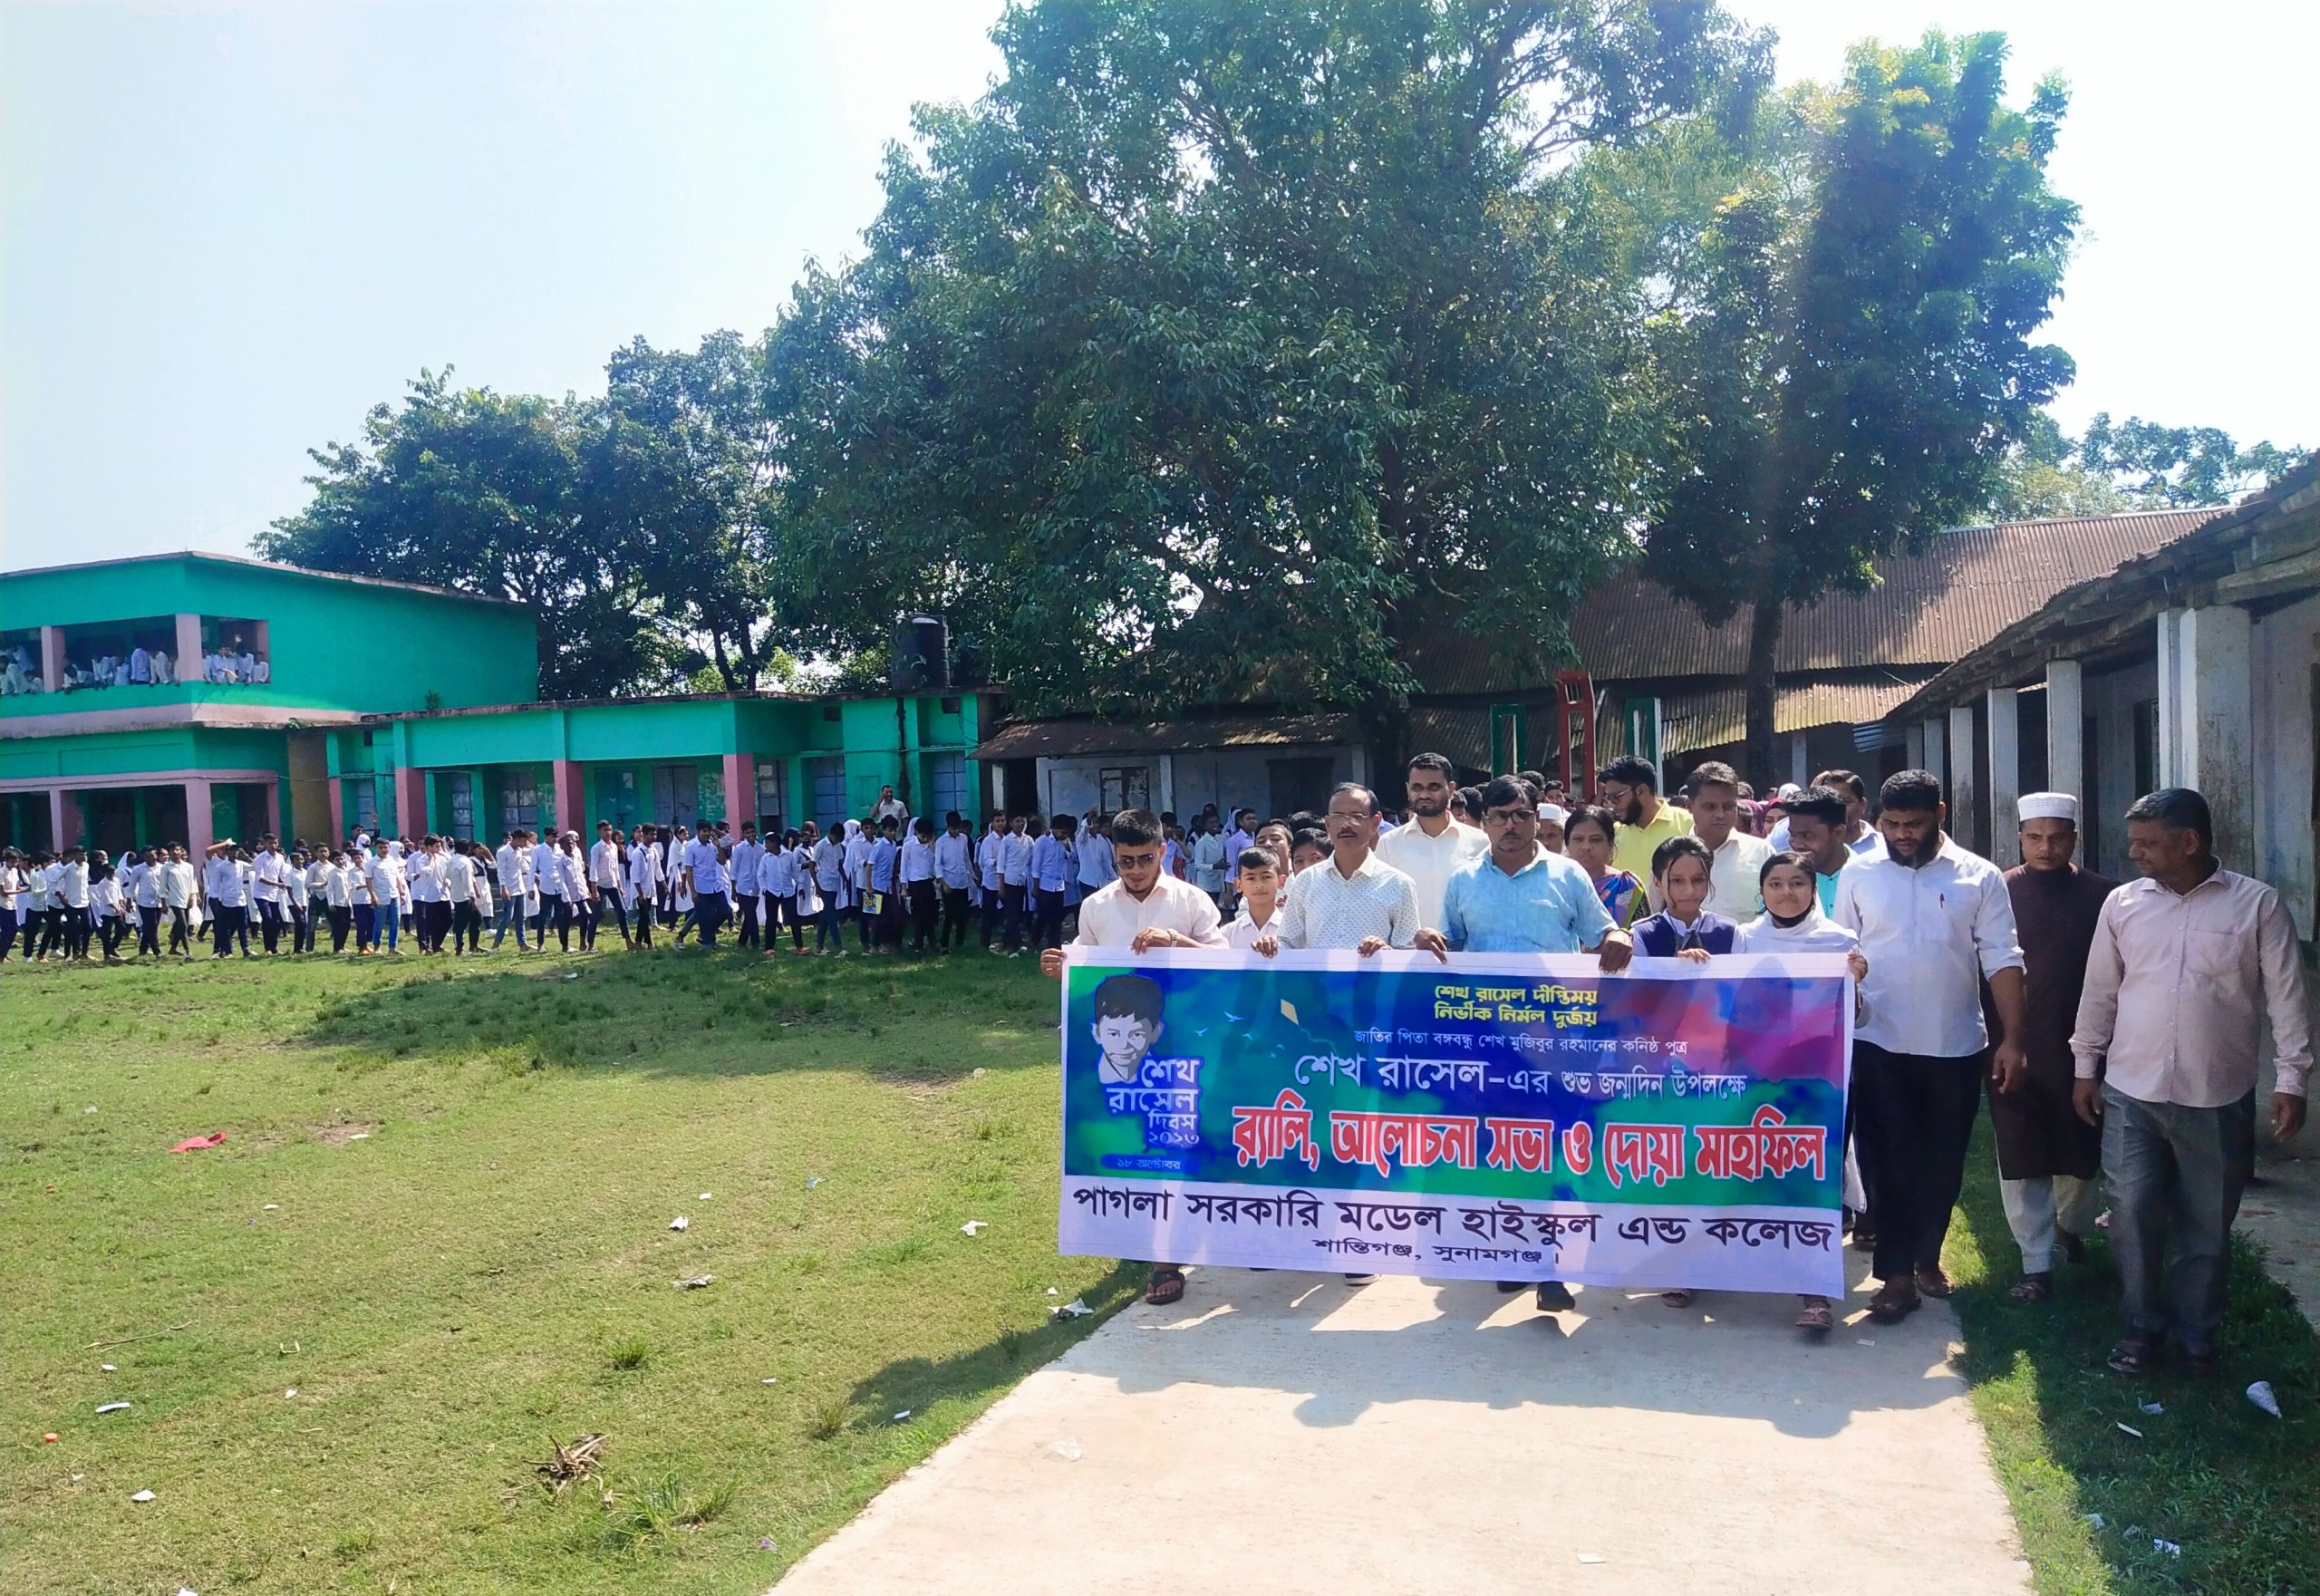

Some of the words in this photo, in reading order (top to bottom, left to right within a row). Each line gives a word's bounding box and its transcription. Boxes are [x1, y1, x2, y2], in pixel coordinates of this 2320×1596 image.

[1435, 985, 1469, 1000] শেখ
[1475, 987, 1526, 1002] রাসেল
[1532, 984, 1597, 1006] দীপ্তিময়
[1435, 1000, 1493, 1021] নির্ভীক
[1498, 1003, 1545, 1023] নির্মল
[1552, 1006, 1597, 1029] দুর্জয়
[1354, 1027, 1393, 1044] জাতির
[1397, 1029, 1428, 1045] পিতা
[1434, 1031, 1474, 1049] বঙ্গবন্ধু
[1478, 1032, 1506, 1049] শেখ
[1510, 1032, 1554, 1053] মুজিবুর
[1559, 1038, 1617, 1053] রহমানের
[1622, 1036, 1658, 1054] কনিষ্ঠ
[1665, 1040, 1688, 1057] পুত্র
[1141, 1059, 1199, 1088] শেখ
[1295, 1052, 1368, 1088] শেখ
[1561, 1070, 1593, 1094] শুভ
[1597, 1065, 1666, 1100] জন্মদিন
[1670, 1065, 1747, 1100] উপলক্ষে
[1106, 1088, 1198, 1114] রাসেল
[1147, 1108, 1197, 1131] দিবস
[1148, 1131, 1200, 1147] ২০২৩
[1329, 1110, 1479, 1178] আলোচনা
[1485, 1117, 1554, 1173] সভা
[1561, 1120, 1593, 1175] ও
[1602, 1122, 1686, 1189] দোয়া
[1694, 1103, 1827, 1182] মাহফিল
[1073, 1185, 1174, 1222] পাগলা
[1184, 1189, 1324, 1229] সরকারি
[1335, 1200, 1449, 1235] মডেল
[1457, 1200, 1603, 1250] হাইস্কুল
[1618, 1215, 1692, 1247] এন্ড
[1701, 1216, 1837, 1252] কলেজ
